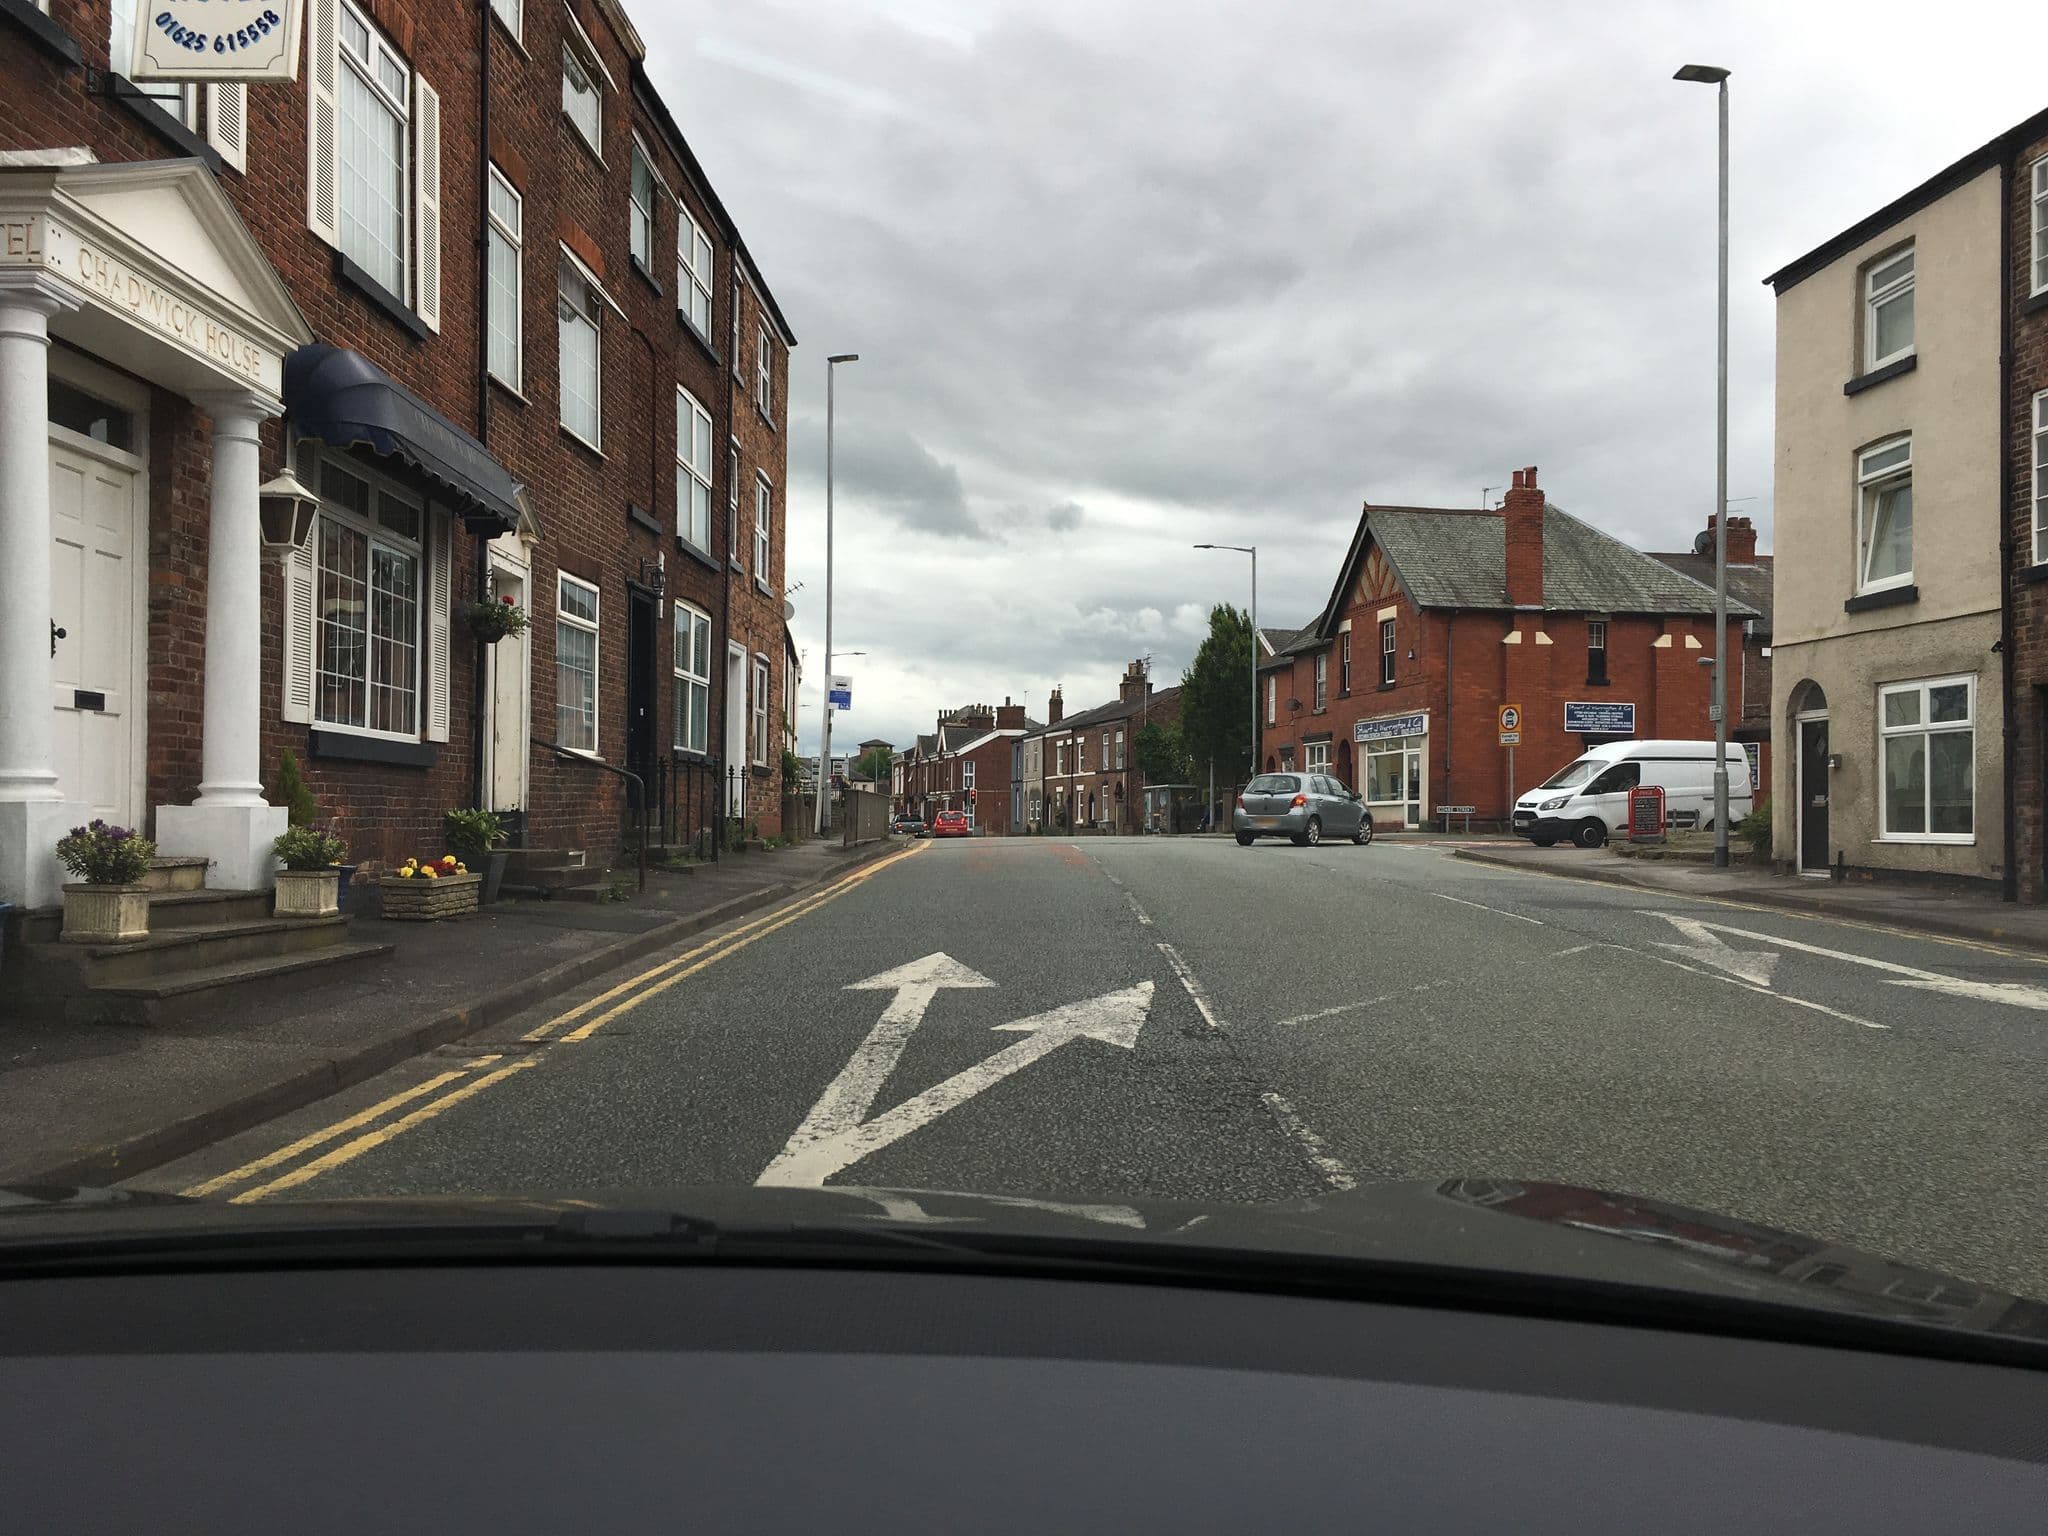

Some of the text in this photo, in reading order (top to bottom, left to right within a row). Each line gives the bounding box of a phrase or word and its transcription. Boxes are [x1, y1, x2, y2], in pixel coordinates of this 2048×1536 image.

[155, 9, 281, 55] 01625 615558
[0, 223, 40, 255] EL
[78, 248, 260, 377] CHADWICK HOUSE
